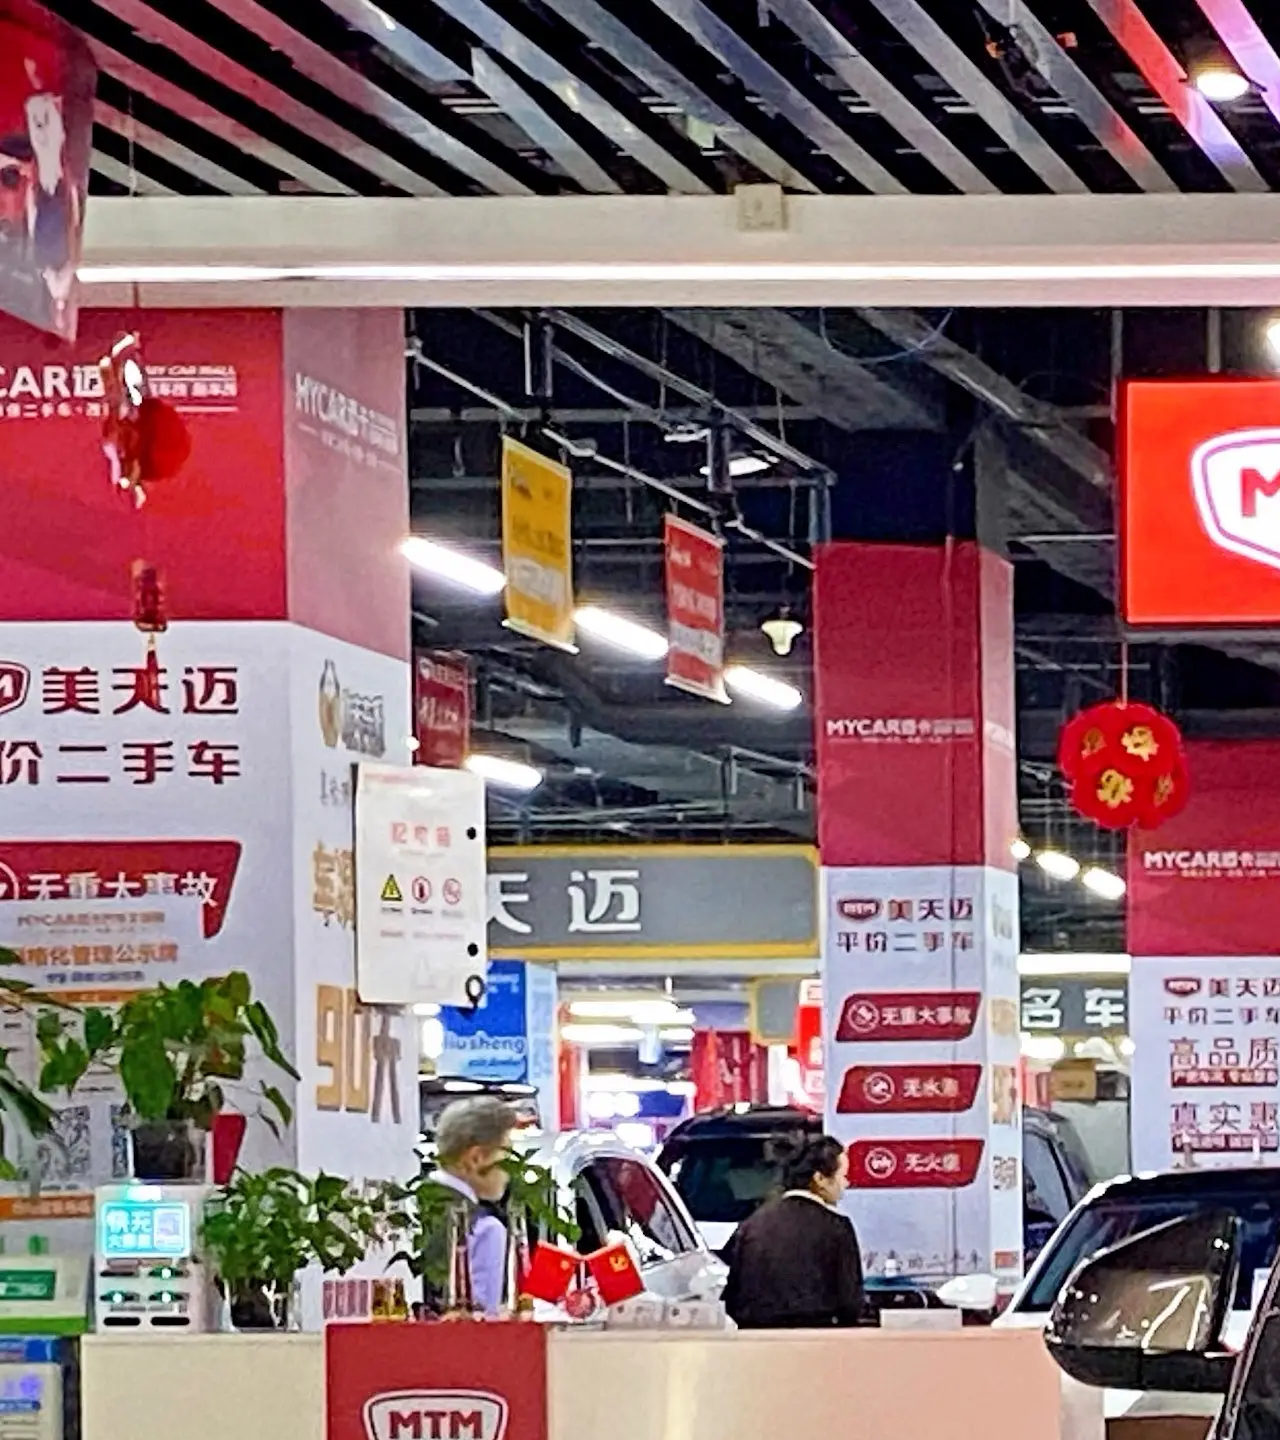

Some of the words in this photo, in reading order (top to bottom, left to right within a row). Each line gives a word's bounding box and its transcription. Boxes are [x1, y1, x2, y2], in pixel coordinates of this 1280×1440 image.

[42, 666, 240, 714] 美天迈
[888, 898, 973, 921] 美天迈
[837, 930, 973, 953] 平价二手车
[1021, 987, 1125, 1028] 名车
[1169, 1036, 1280, 1070] 高品质
[1170, 1101, 1280, 1132] 真实惠
[389, 1410, 483, 1440] MTM
